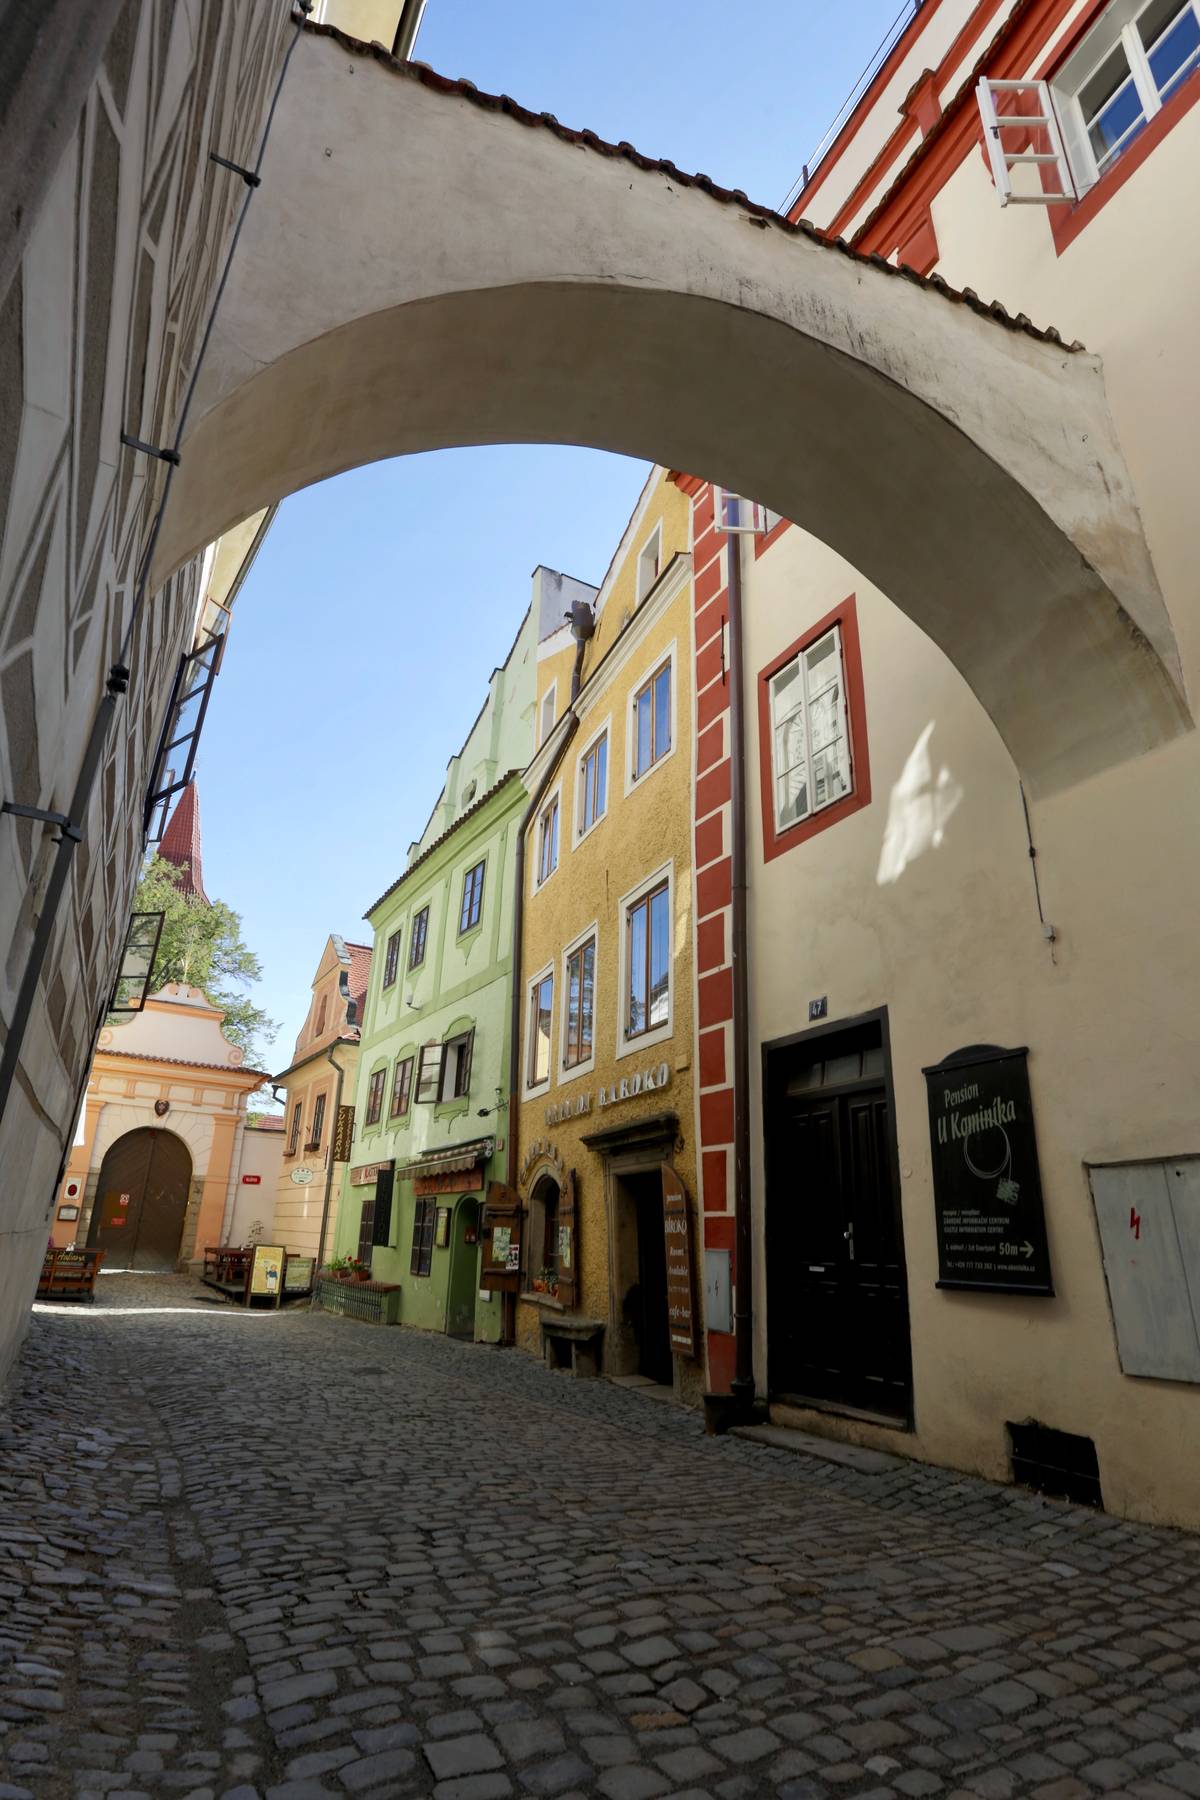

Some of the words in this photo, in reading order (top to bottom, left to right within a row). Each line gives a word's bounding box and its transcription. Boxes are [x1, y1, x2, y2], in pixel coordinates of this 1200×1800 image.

[598, 1062, 670, 1106] BAROKO
[944, 1083, 979, 1108] Pension
[937, 1116, 948, 1144] U
[999, 1242, 1018, 1255] 50m
